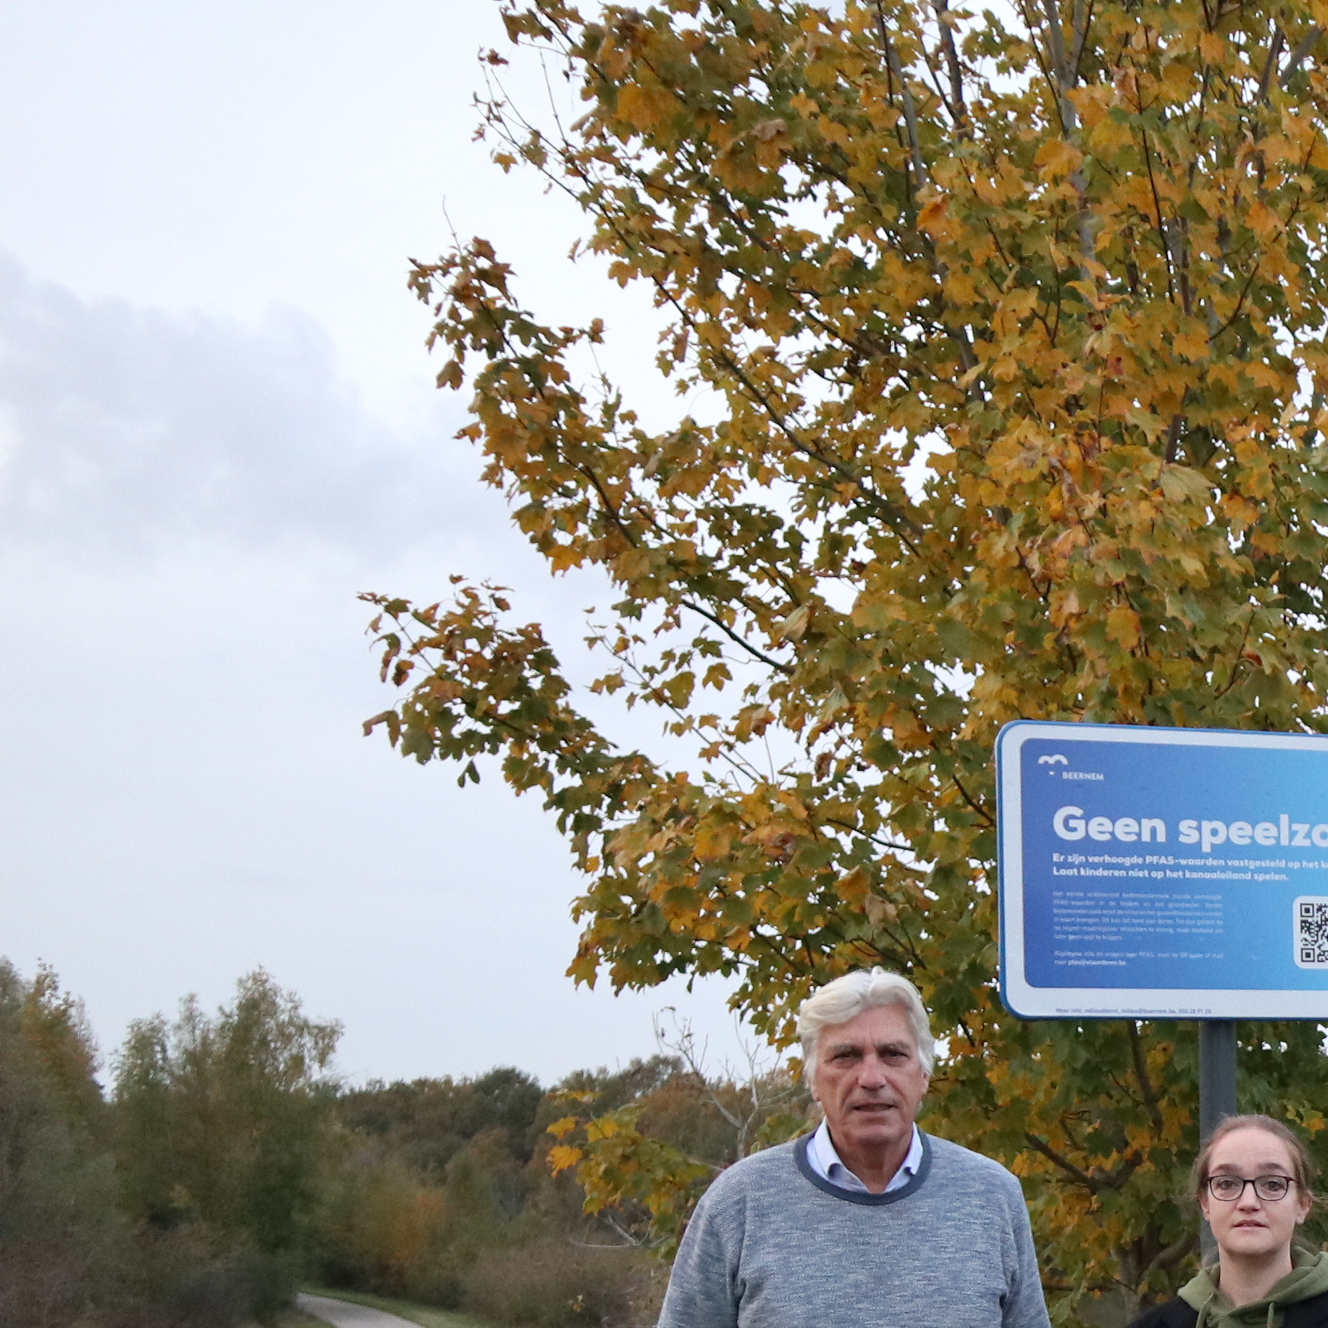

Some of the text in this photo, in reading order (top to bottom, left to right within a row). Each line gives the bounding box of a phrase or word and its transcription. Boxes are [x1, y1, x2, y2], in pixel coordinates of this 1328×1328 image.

[1062, 771, 1104, 780] BEERNEM
[1053, 805, 1167, 843] Geen
[1052, 853, 1065, 863] Er
[1067, 853, 1086, 865] zijn
[1087, 854, 1143, 866] verhoogde
[1145, 855, 1225, 867] PFAS-waarden
[1227, 858, 1286, 869] vastgesteld
[1287, 861, 1300, 870] op
[1302, 859, 1318, 869] het
[1053, 866, 1289, 881] Laat kinderen niet op het kanaaleiland spelen.
